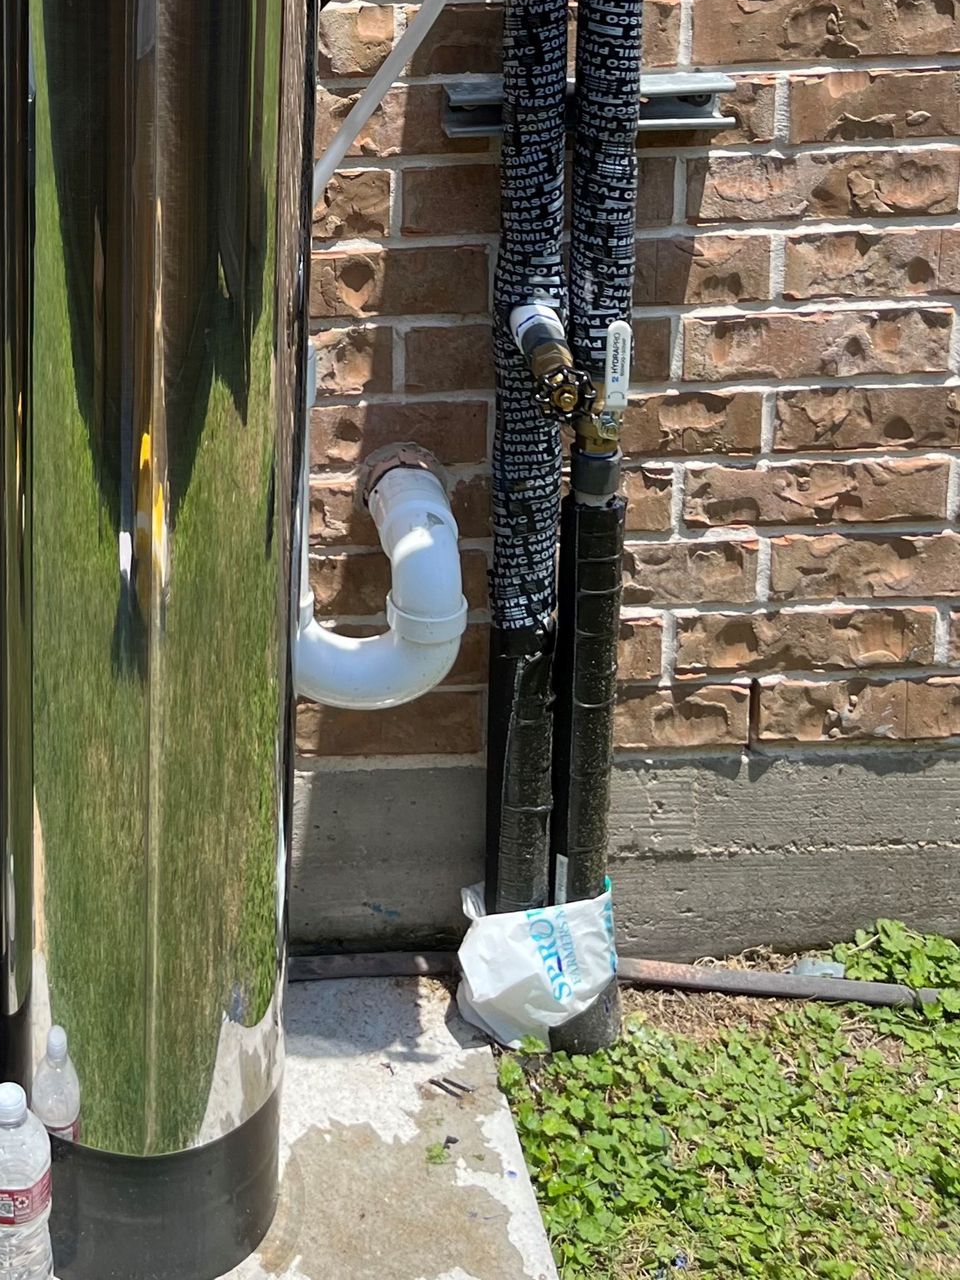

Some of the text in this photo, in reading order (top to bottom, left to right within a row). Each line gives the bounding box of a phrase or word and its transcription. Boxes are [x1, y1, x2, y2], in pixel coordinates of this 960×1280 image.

[508, 46, 535, 57] PVC
[519, 94, 562, 107] WRAP
[517, 104, 565, 121] PASCO
[519, 118, 562, 132] 20MIL
[521, 125, 566, 143] PASCO
[506, 152, 547, 165] 20MIL
[594, 153, 629, 165] PIPE
[505, 162, 548, 177] WRAP
[508, 174, 553, 188] 20MIL
[589, 184, 620, 198] PVC
[512, 191, 560, 209] PASCO
[597, 212, 631, 220] PIPE
[506, 219, 553, 230] PASCO
[506, 231, 550, 241] 20MIL
[608, 237, 634, 246] PIPE
[500, 260, 548, 275] PASCO
[598, 265, 627, 275] PVC
[497, 282, 545, 294] PASCO
[604, 288, 632, 297] PIPE
[600, 298, 627, 308] PVC
[573, 315, 601, 326] PVC
[573, 337, 602, 348] PVC
[611, 332, 620, 374] HYDRAPRO
[503, 433, 548, 441] 20MIL
[503, 443, 548, 452] WRAP
[504, 453, 552, 462] 20MIL
[505, 467, 550, 479] WRAP
[509, 485, 554, 500] WRAP
[499, 515, 528, 525] PVC
[497, 536, 524, 545] PVC
[495, 546, 525, 555] PIPE
[499, 557, 529, 565] PVC
[498, 566, 529, 576] PIPE
[494, 576, 521, 586] PIPE
[497, 595, 528, 607] PIPE
[502, 617, 534, 629] PIPE
